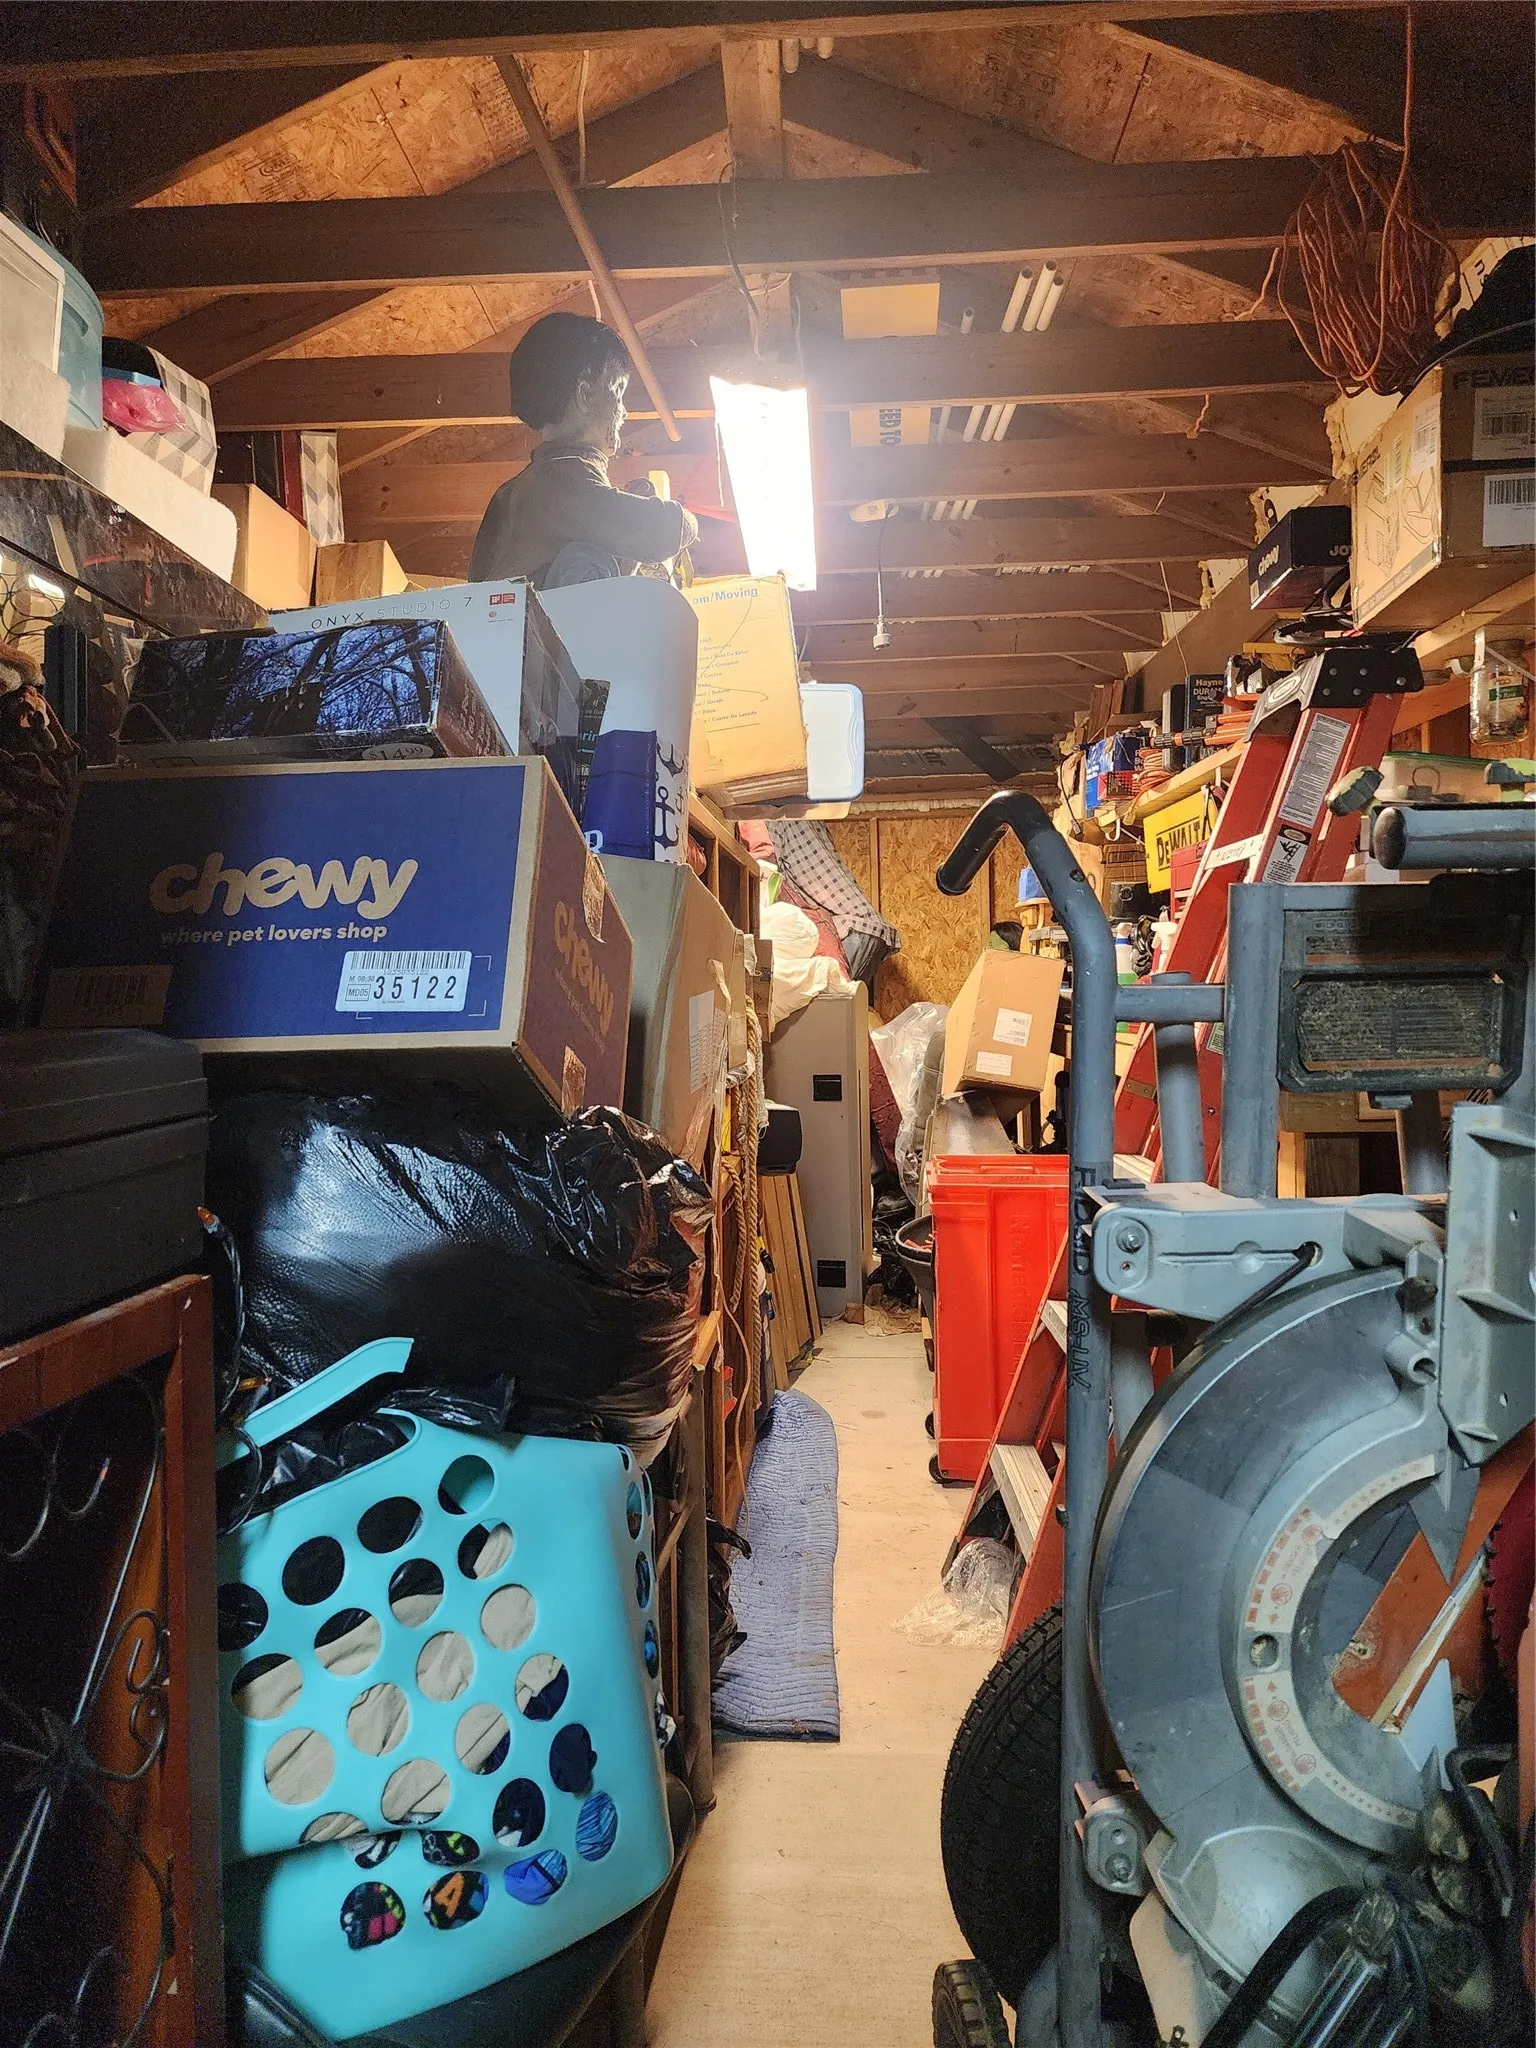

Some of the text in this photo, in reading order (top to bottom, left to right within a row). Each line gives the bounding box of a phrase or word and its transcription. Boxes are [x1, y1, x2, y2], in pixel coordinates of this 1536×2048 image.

[1328, 545, 1352, 557] JO
[311, 596, 472, 630] ONYX STUDIO 7
[150, 851, 419, 920] chewy
[161, 921, 388, 946] where pet lovers shop
[373, 975, 458, 1000] 35122
